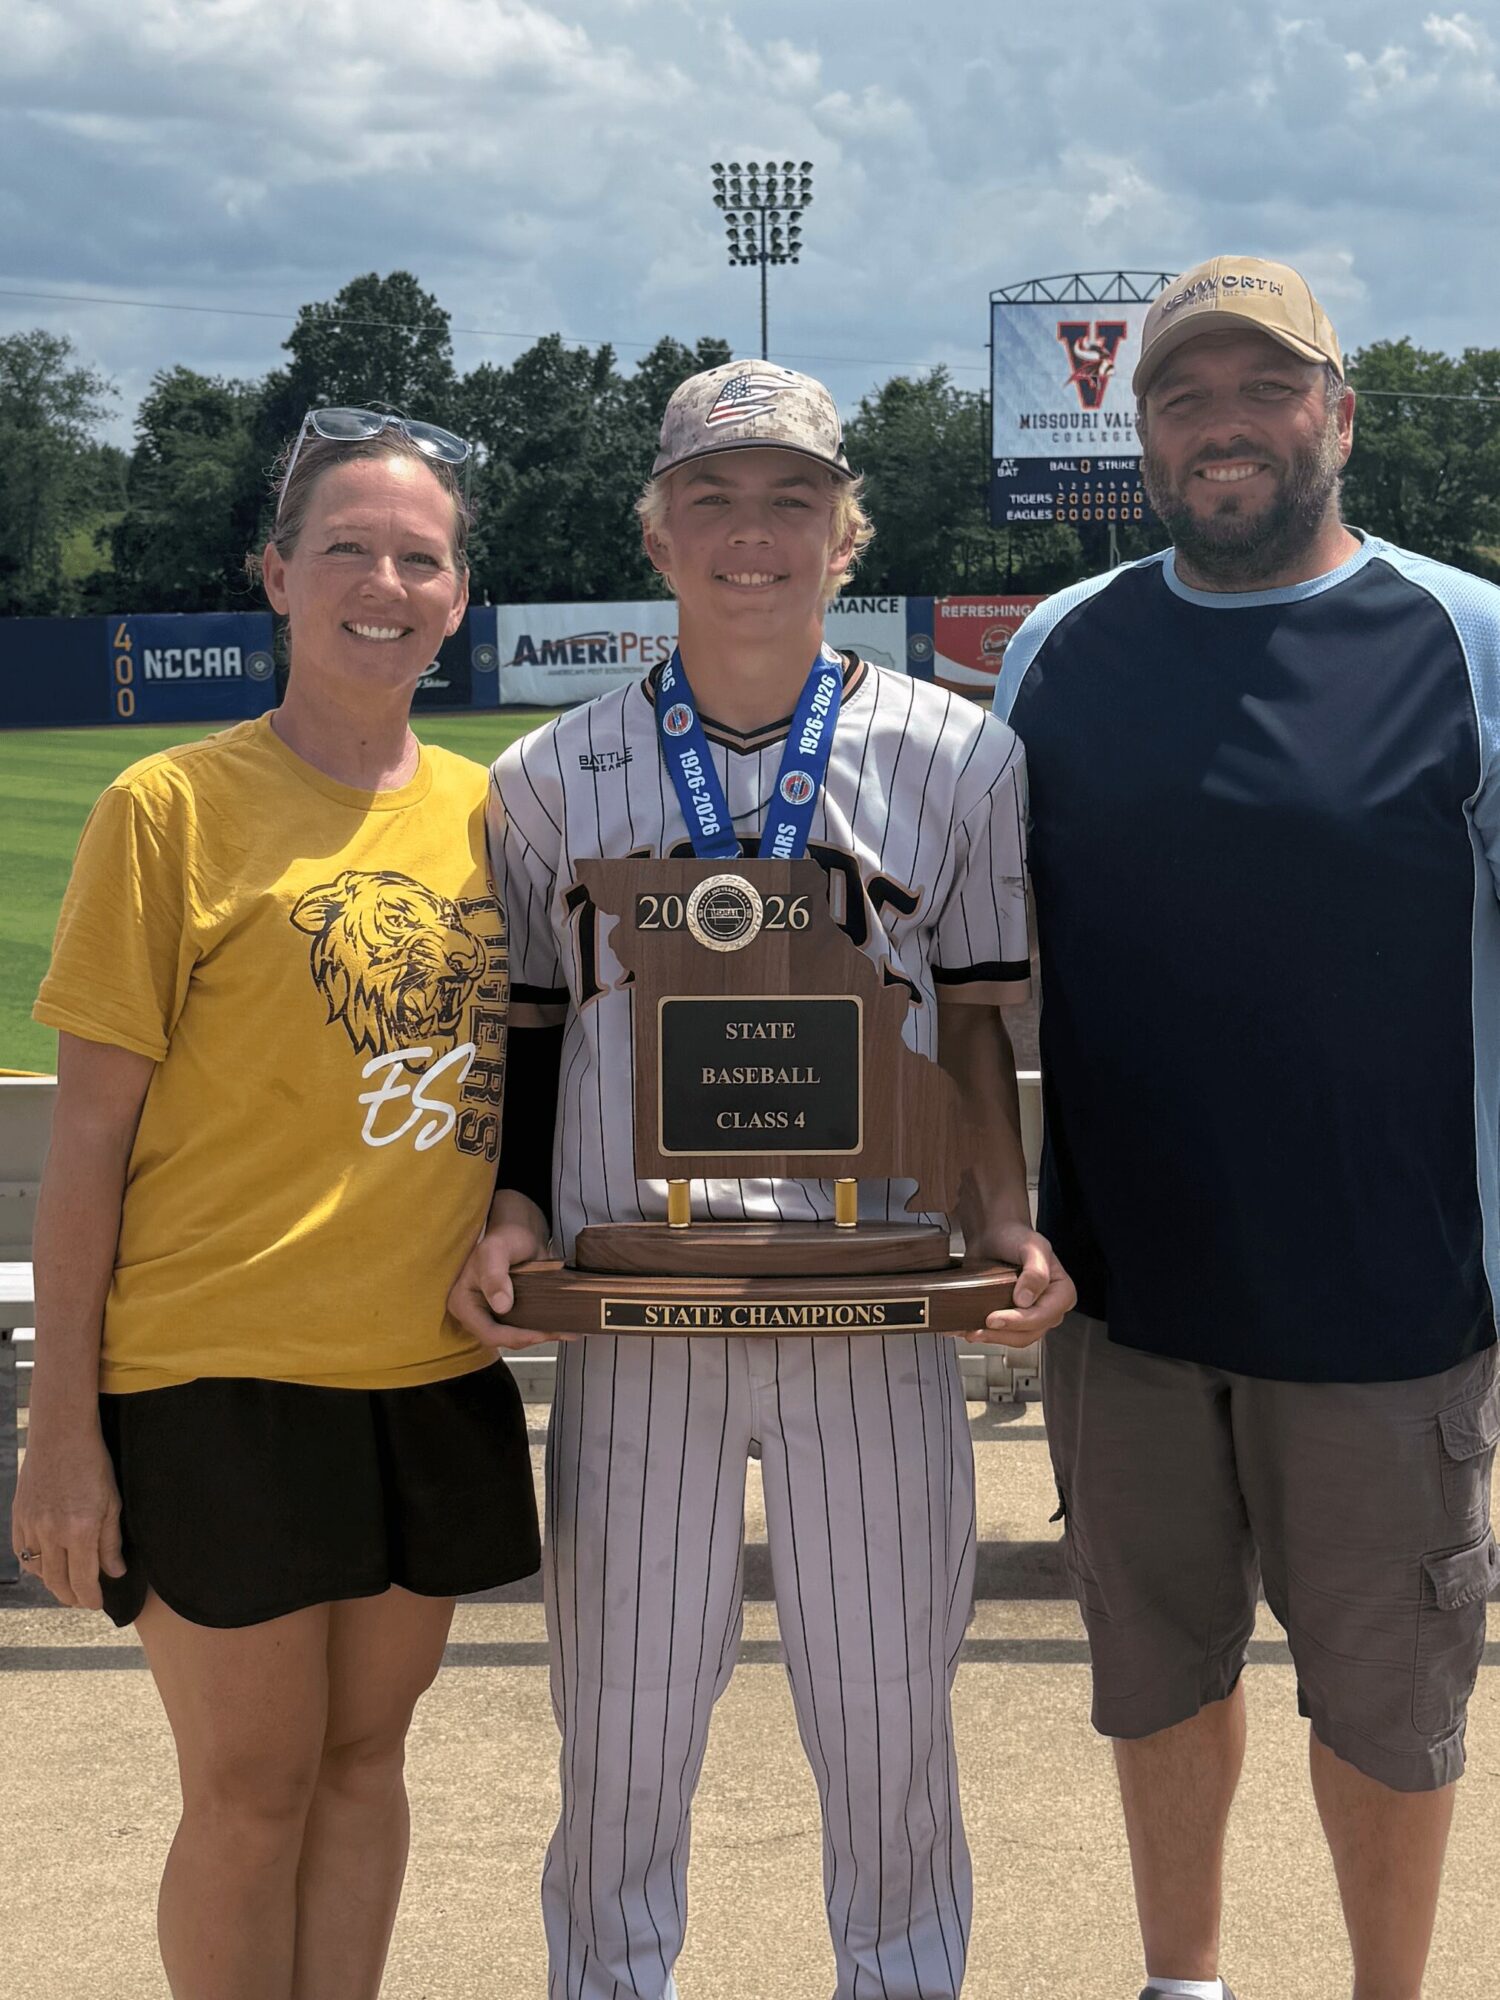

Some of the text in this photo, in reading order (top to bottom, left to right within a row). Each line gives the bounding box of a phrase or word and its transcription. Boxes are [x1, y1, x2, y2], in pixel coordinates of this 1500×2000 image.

[1019, 412, 1138, 429] MISSOURI VAL
[1052, 432, 1132, 443] COLLEGE
[1000, 459, 1015, 467] AT
[1050, 459, 1136, 473] BALL 0 STRIKE
[997, 468, 1019, 477] BAT
[1009, 492, 1143, 505] TIGERS 2 0 0 0 0 0 0
[1006, 510, 1053, 520] EAGLES
[941, 603, 1032, 618] REFRESHING
[113, 622, 135, 717] 400
[144, 646, 242, 679] NCCAA
[798, 673, 837, 756] 1926-2026
[579, 746, 633, 766] BATTLE
[679, 747, 721, 837] 1926-2026
[638, 895, 684, 930] 20
[764, 894, 810, 930] 26
[725, 1022, 796, 1040] STATE
[701, 1067, 821, 1084] BASEBALL
[716, 1111, 805, 1129] CLASS 4
[644, 1304, 886, 1326] STATE CHAMPIONS
